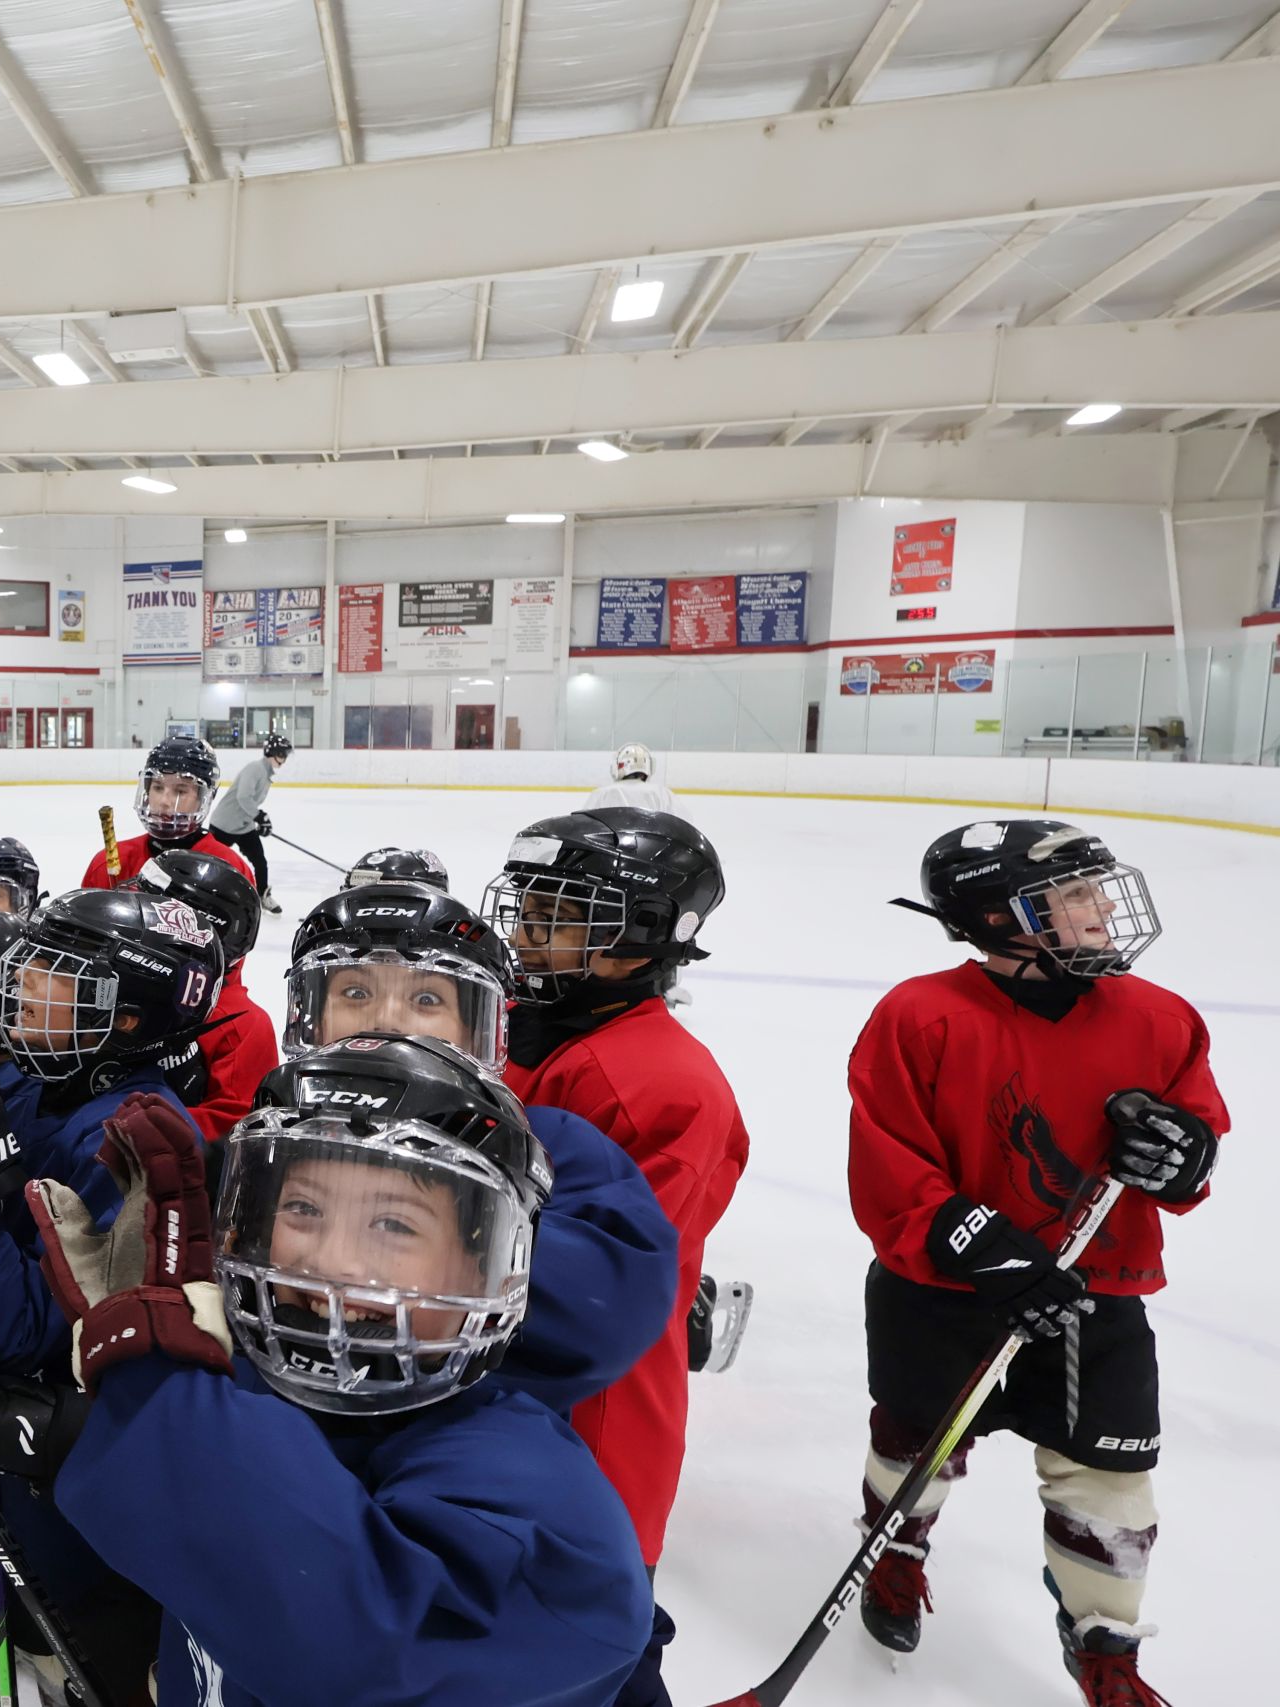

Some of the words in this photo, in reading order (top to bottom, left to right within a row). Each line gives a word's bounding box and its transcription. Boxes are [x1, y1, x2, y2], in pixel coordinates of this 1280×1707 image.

[127, 590, 169, 610] THANK
[171, 590, 197, 608] YOU
[215, 614, 228, 623] 20
[279, 612, 292, 621] 20
[308, 633, 318, 642] 14
[423, 625, 466, 636] ACHA
[243, 636, 254, 644] 14
[620, 870, 659, 884] CCM
[955, 863, 1001, 882] BAUER
[356, 907, 418, 918] CCM
[182, 932, 206, 945] CLIFTON
[119, 949, 174, 976] BAUER
[180, 968, 207, 1007] 13
[311, 1090, 388, 1109] CCM
[165, 1209, 180, 1275] BAUER
[822, 1509, 906, 1634] BAUER
